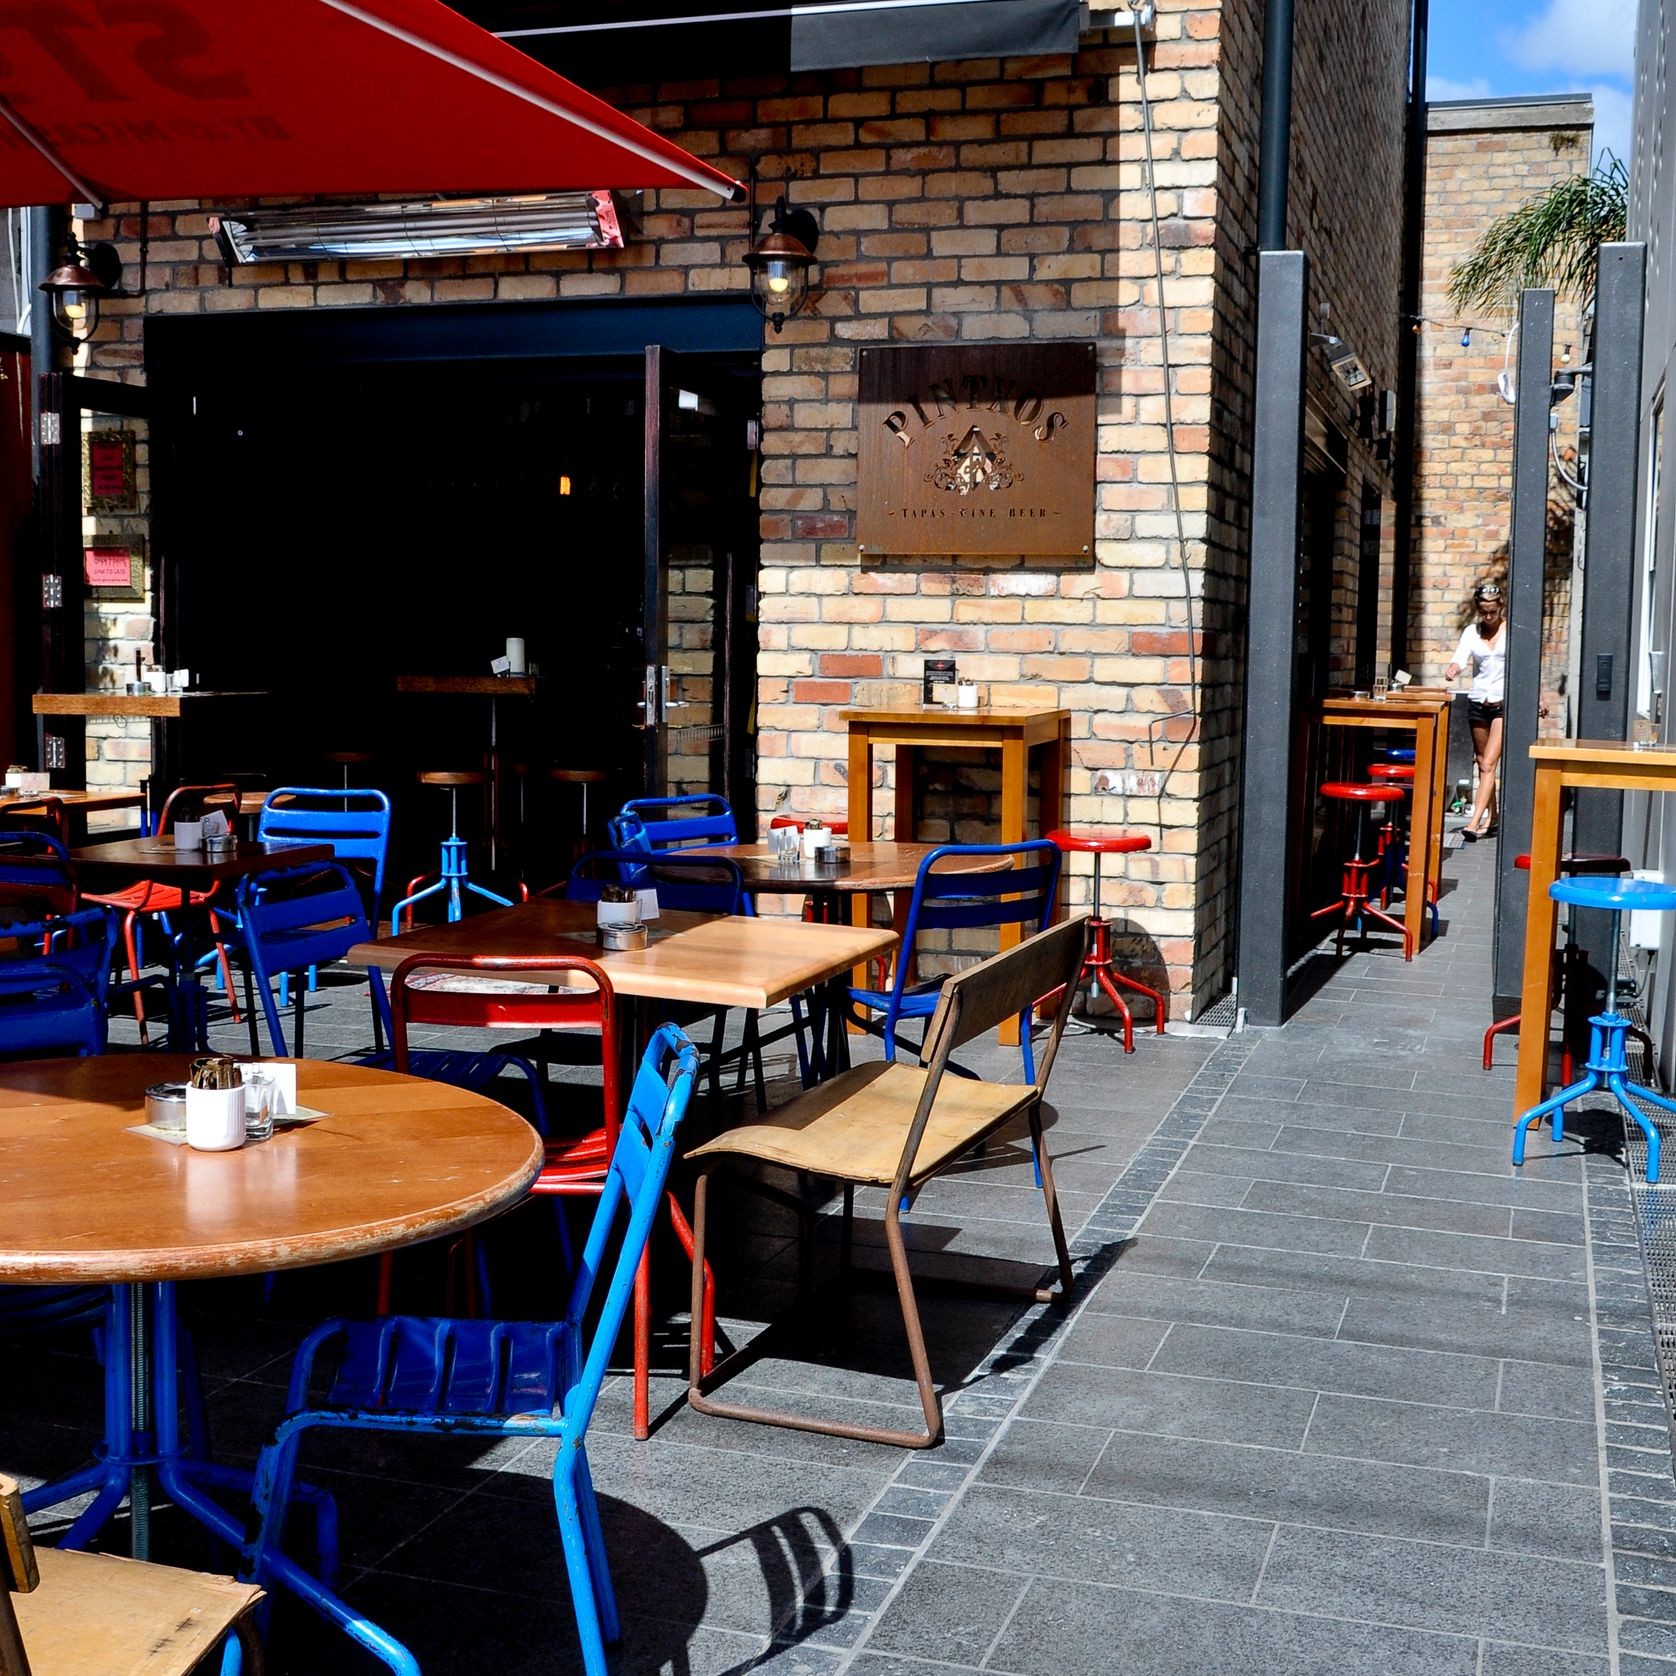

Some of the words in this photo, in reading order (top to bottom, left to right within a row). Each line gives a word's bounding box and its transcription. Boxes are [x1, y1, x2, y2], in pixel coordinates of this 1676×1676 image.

[882, 374, 1069, 449] PINTXOS
[901, 507, 946, 519] TAPAS
[1008, 507, 1047, 519] BEER
